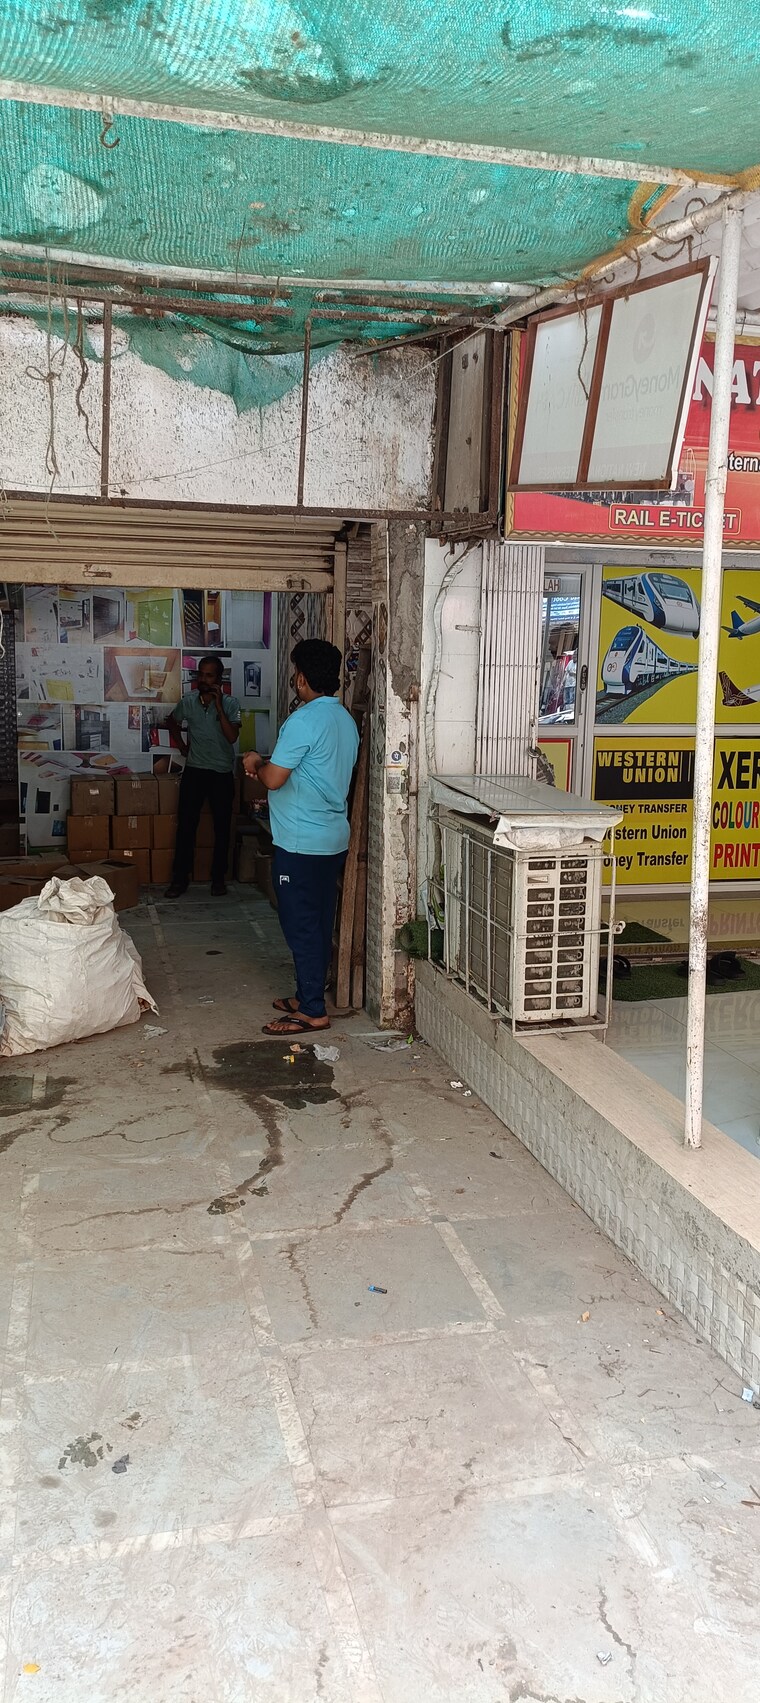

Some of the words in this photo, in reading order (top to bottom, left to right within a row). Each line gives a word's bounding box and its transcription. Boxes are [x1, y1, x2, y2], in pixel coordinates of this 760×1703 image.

[728, 452, 760, 471] tern
[615, 509, 654, 526] RAIL
[659, 510, 737, 529] E-TICT
[597, 751, 679, 767] WESTERN
[622, 768, 679, 783] UNION
[606, 804, 635, 814] NEY
[638, 803, 688, 813] TRANSFER
[712, 801, 760, 829] COLOUR
[603, 826, 647, 840] estern
[651, 824, 687, 839] Union
[637, 851, 689, 866] Transfer
